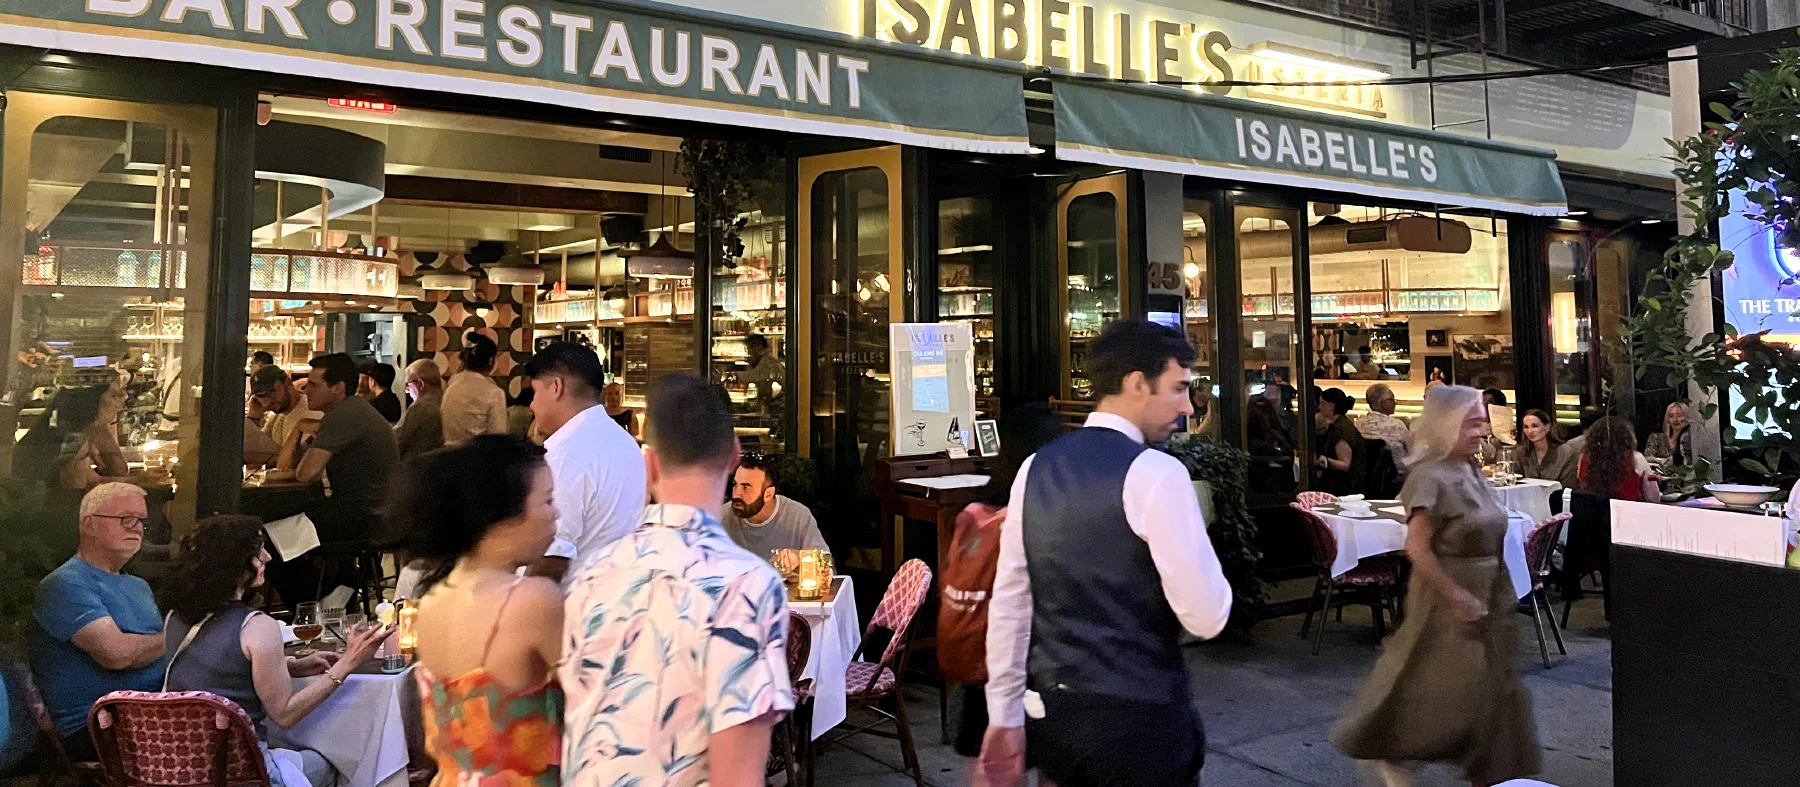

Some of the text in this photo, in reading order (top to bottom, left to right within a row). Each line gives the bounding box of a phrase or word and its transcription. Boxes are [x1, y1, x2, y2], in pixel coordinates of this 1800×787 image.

[375, 0, 870, 109] RESTAURANT
[1235, 117, 1438, 183] ISABELLE'S
[1738, 299, 1772, 314] THE
